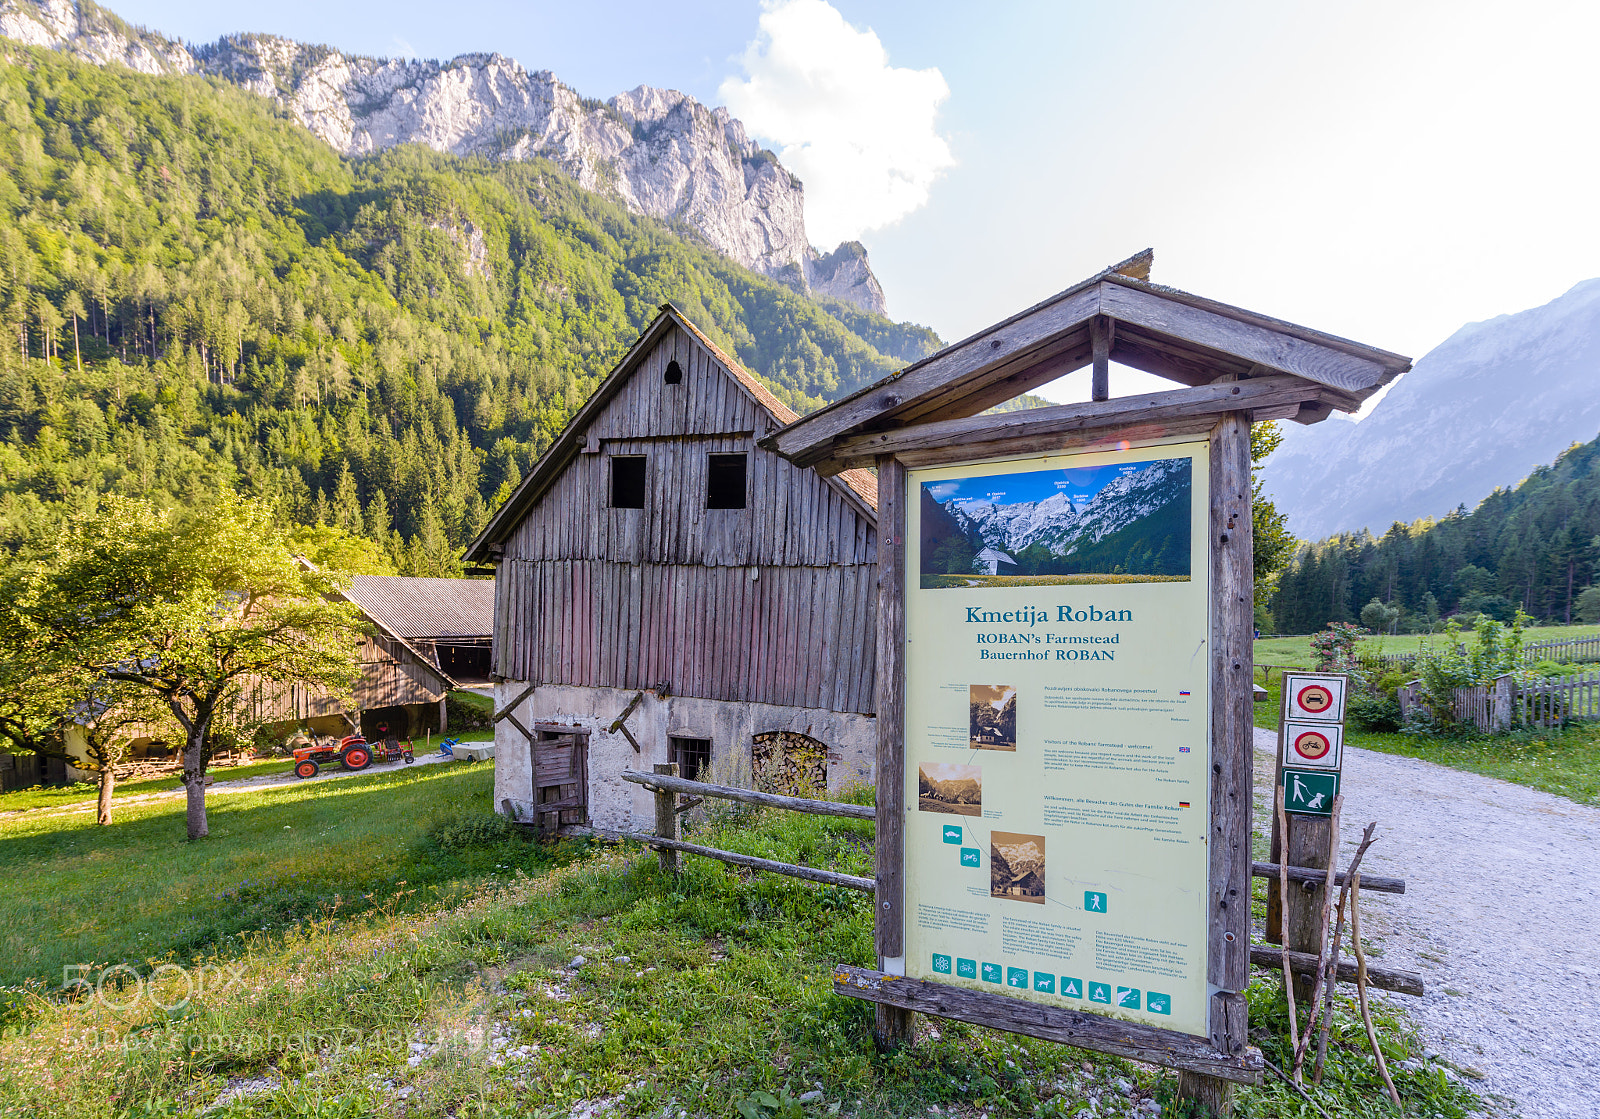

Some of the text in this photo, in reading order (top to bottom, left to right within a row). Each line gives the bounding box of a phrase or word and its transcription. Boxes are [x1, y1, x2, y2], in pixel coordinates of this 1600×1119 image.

[965, 604, 1133, 628] Kmetija Roban
[976, 634, 1120, 644] ROBAN's Farmstead
[980, 650, 1115, 660] Bauernhof ROBAN
